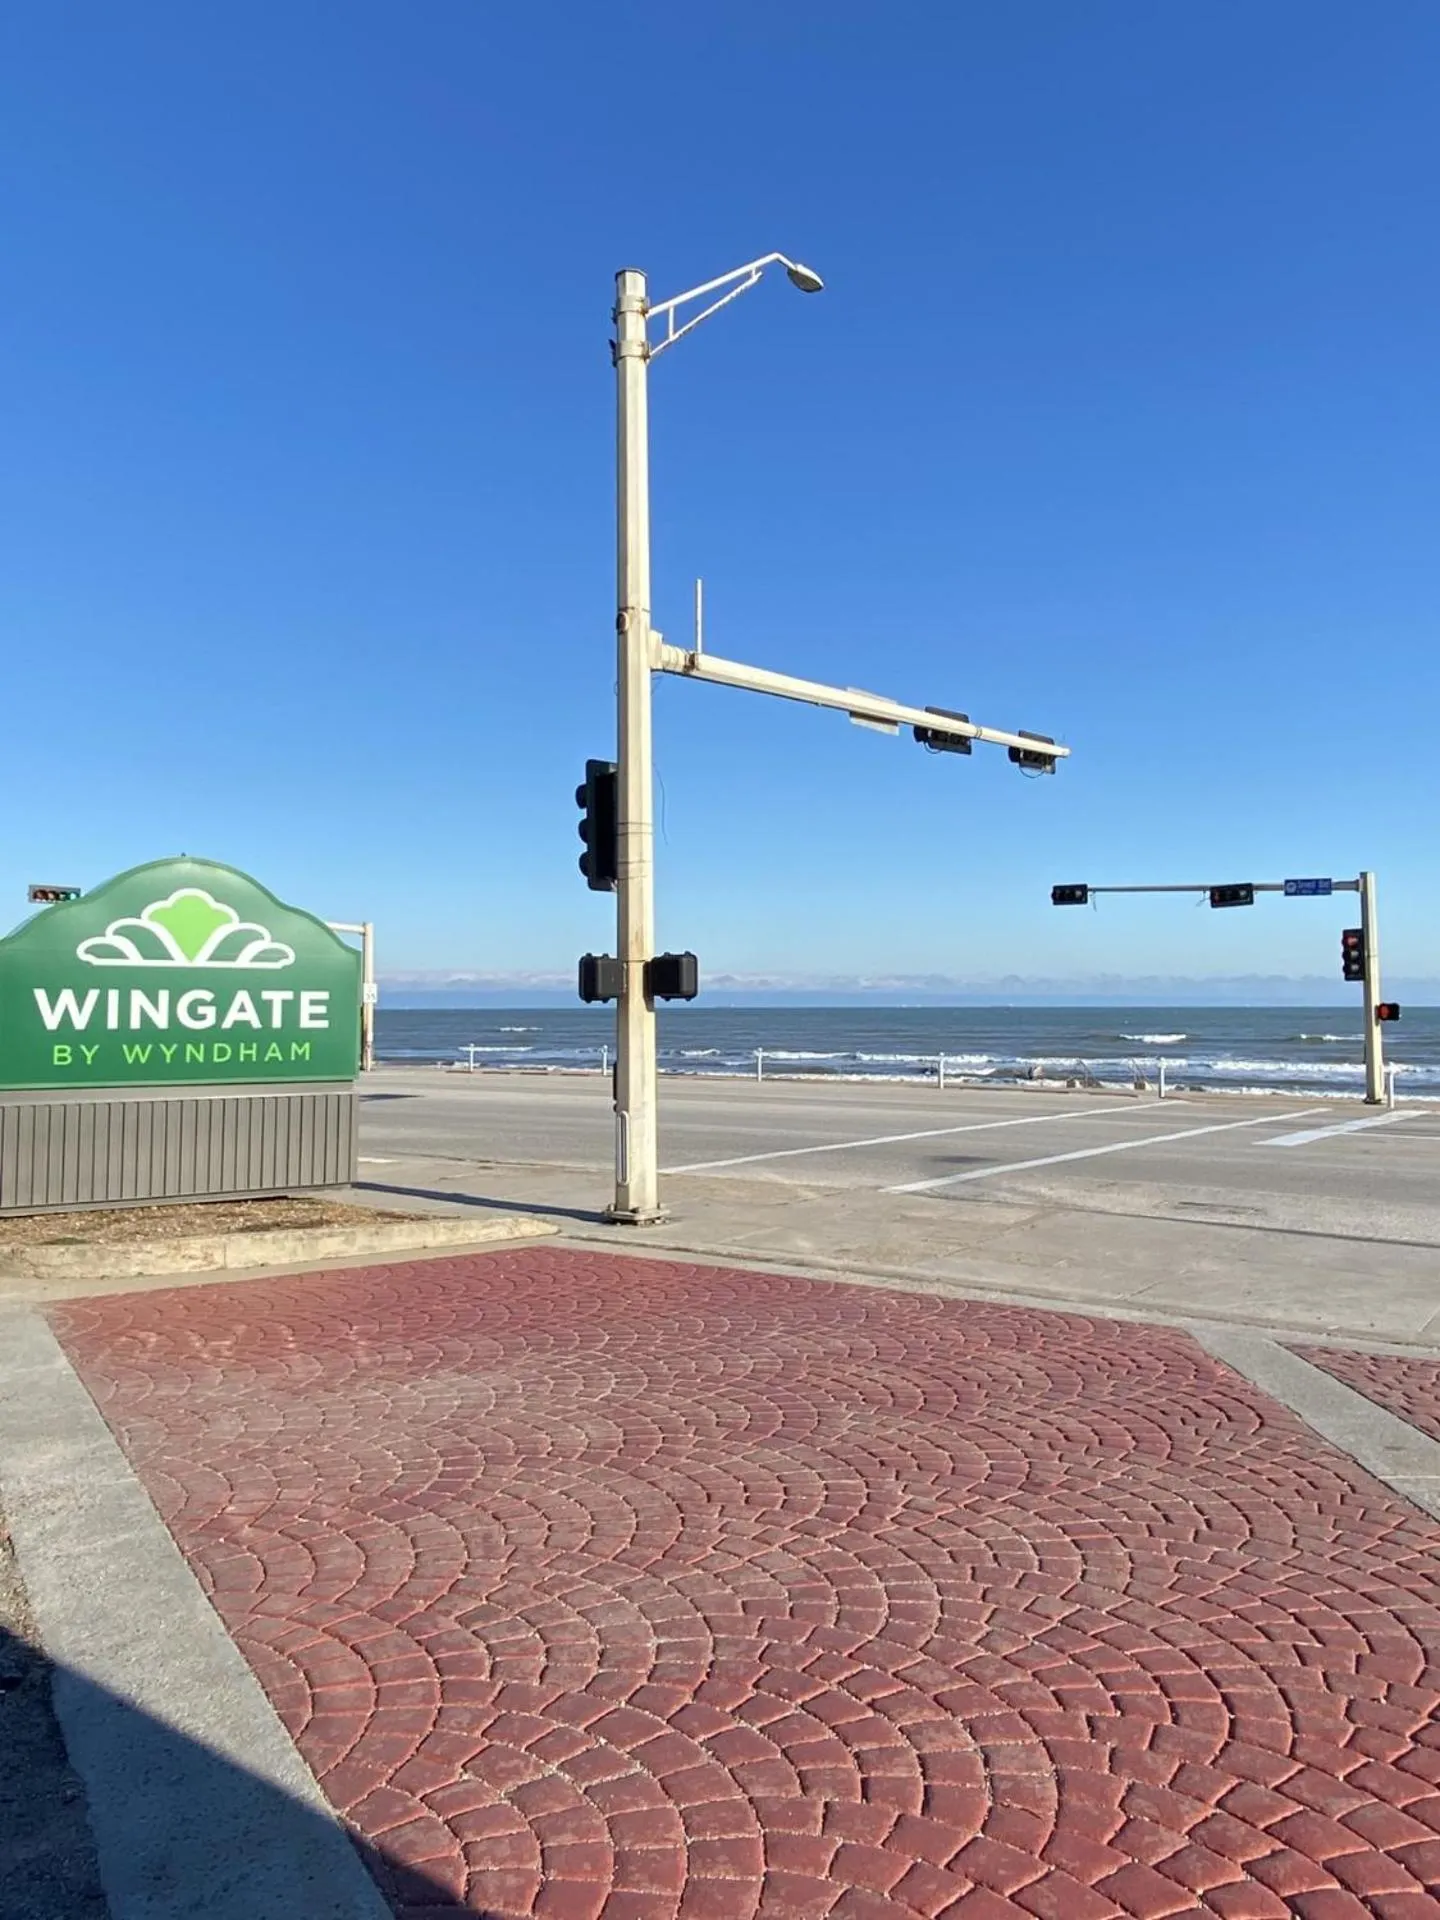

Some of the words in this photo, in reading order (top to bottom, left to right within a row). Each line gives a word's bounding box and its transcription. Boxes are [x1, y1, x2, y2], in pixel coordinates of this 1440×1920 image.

[33, 988, 331, 1030] WINGATE
[53, 1044, 99, 1065] BY
[122, 1042, 311, 1064] WYNDHAM
